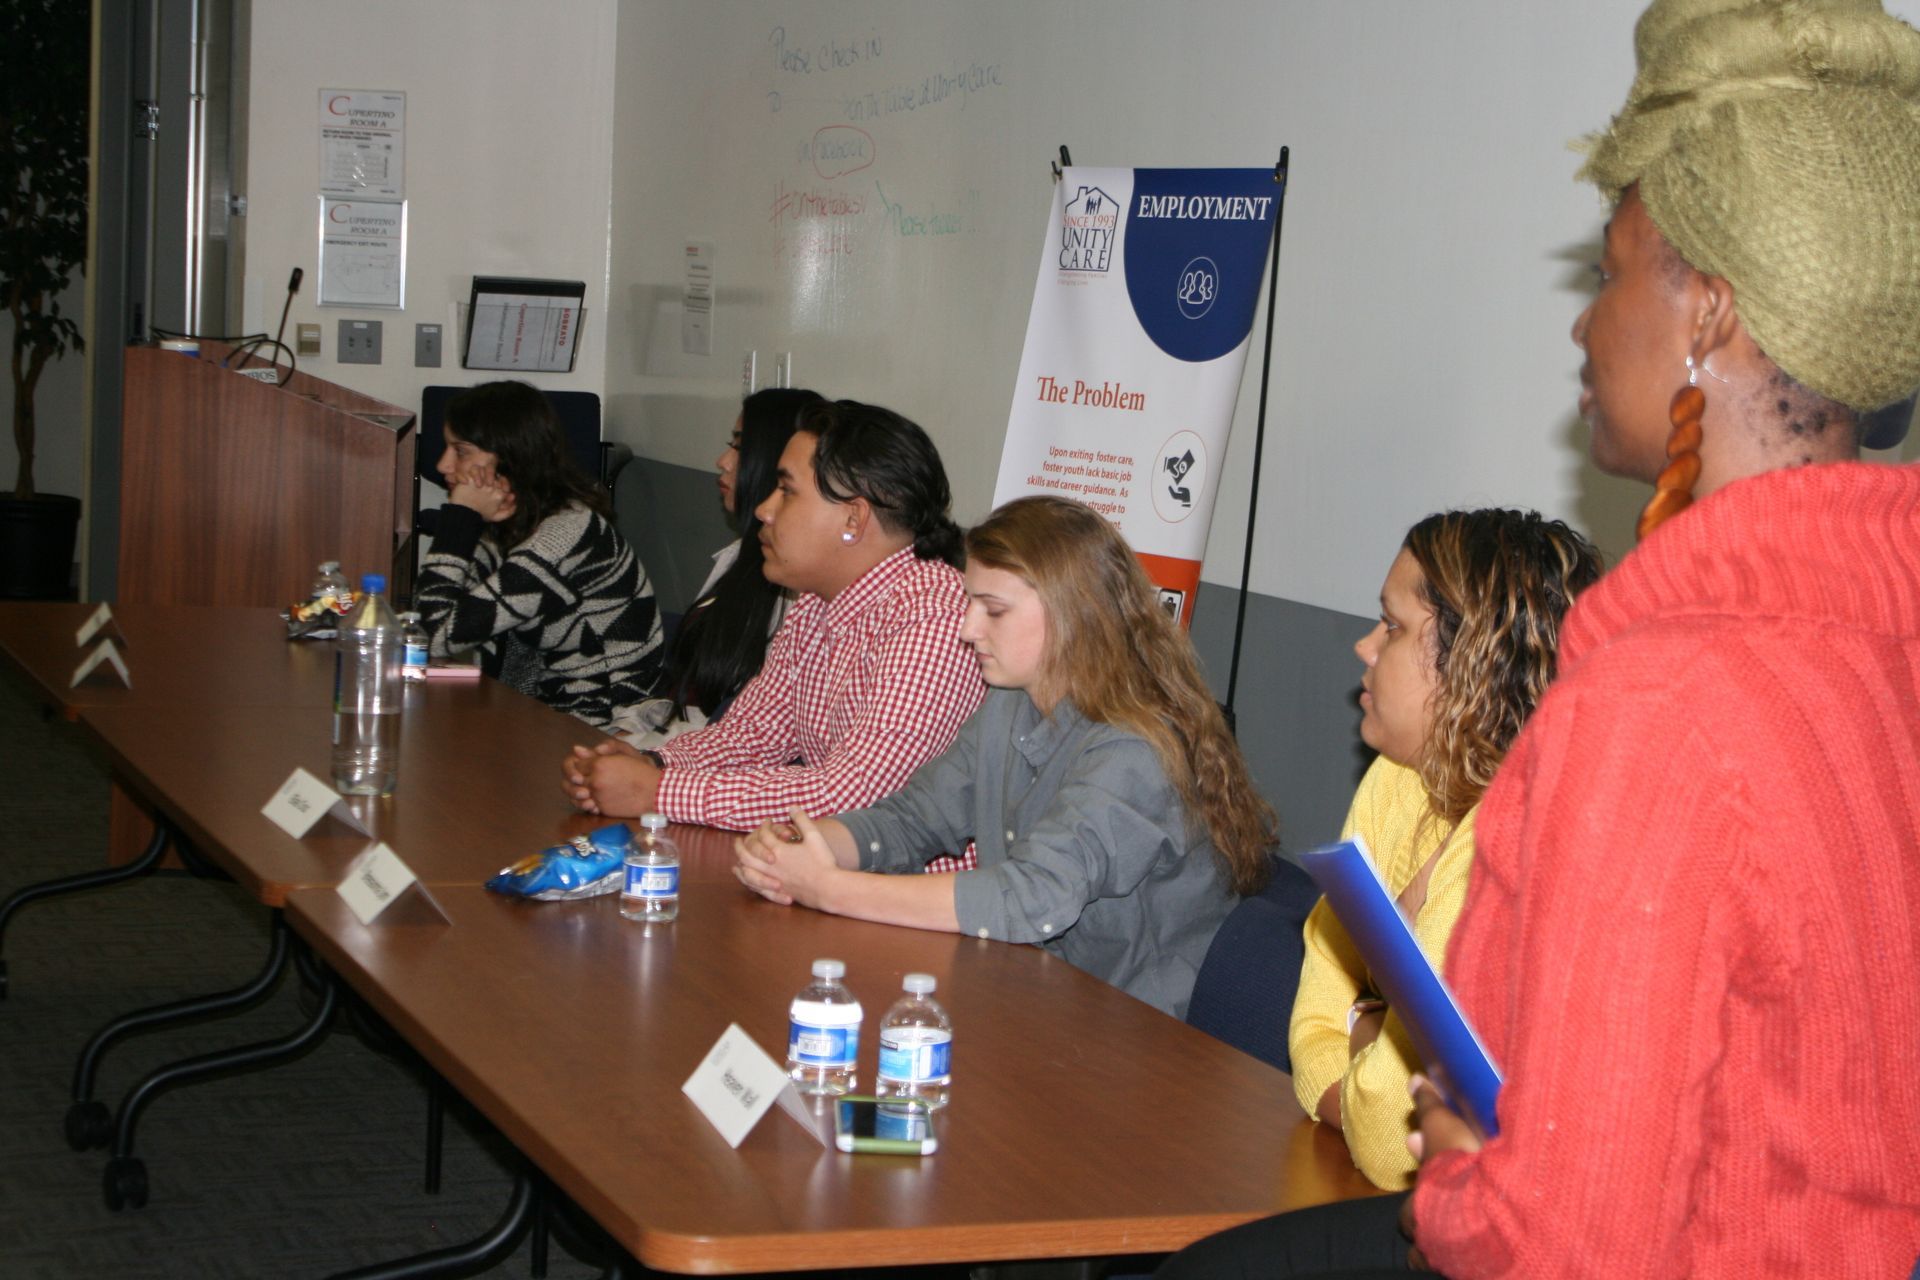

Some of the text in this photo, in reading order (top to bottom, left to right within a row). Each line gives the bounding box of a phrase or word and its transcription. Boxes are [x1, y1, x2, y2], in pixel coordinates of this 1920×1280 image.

[1137, 195, 1272, 221] EMPLOYMENT
[1063, 214, 1116, 229] SINCE 1993
[1062, 227, 1113, 249] UNITY
[1059, 248, 1107, 270] CARE
[1037, 376, 1146, 411] The Problem
[1049, 446, 1068, 458] Upon
[1069, 449, 1094, 462] exiting
[1096, 451, 1117, 462] foster
[1042, 461, 1132, 483] foster youth lack basic job
[1026, 475, 1129, 498] skills and career guidance. As
[1087, 500, 1117, 514] struggle
[1117, 503, 1126, 514] to
